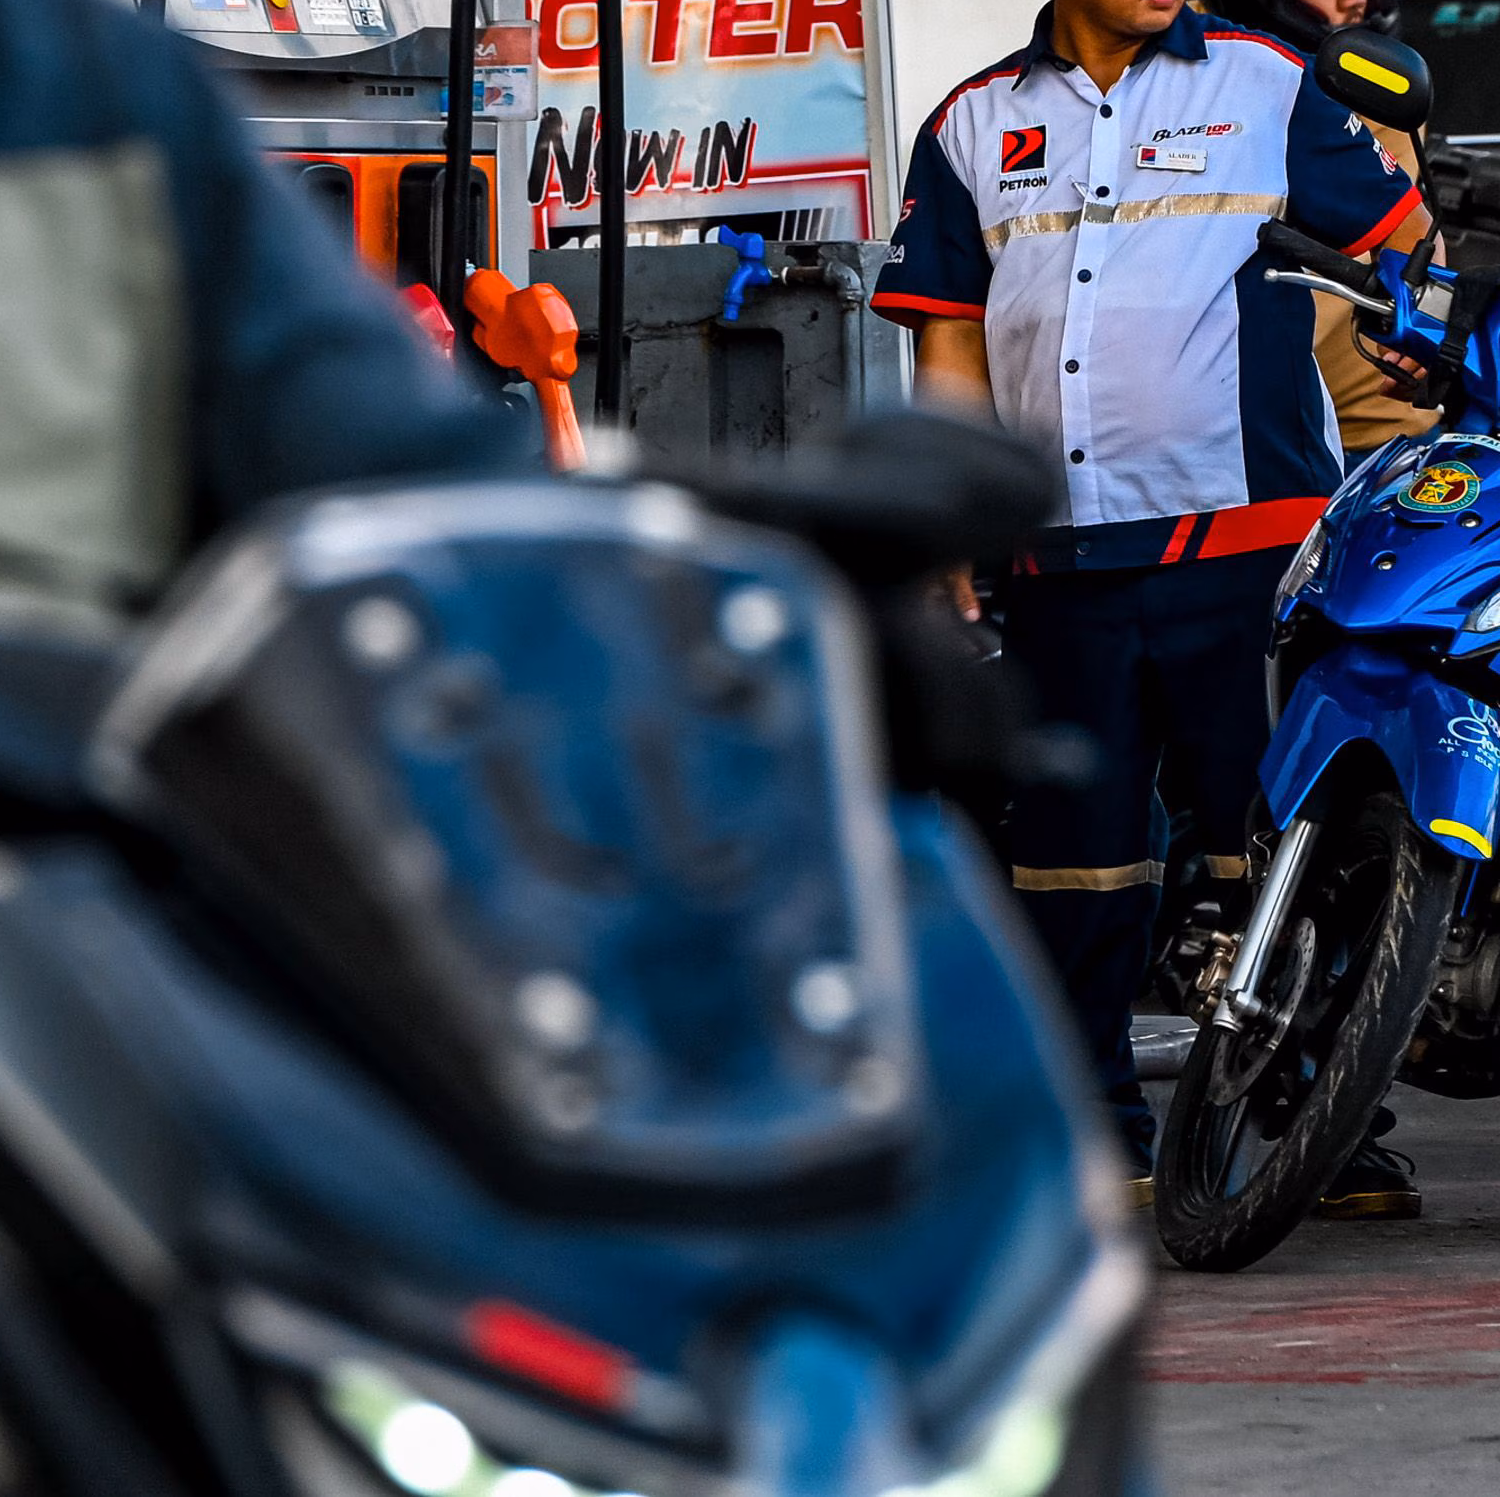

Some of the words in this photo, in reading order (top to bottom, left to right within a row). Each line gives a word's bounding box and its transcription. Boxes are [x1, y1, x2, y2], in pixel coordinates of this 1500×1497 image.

[692, 117, 757, 193] IN
[999, 175, 1048, 194] PETRON
[1438, 737, 1461, 747] ALL
